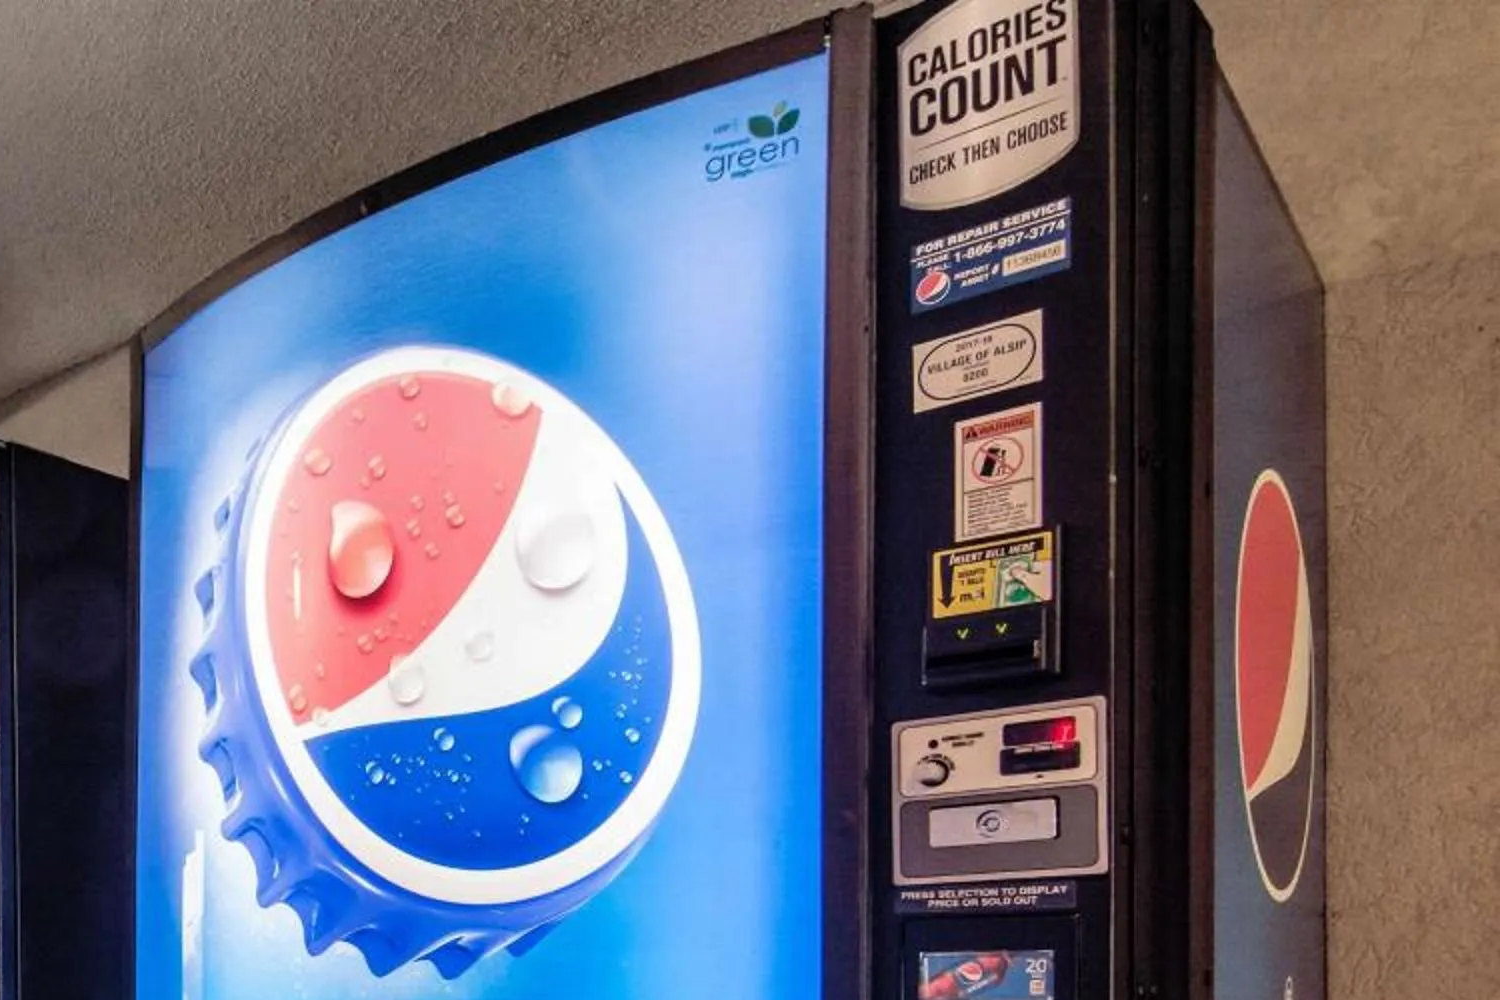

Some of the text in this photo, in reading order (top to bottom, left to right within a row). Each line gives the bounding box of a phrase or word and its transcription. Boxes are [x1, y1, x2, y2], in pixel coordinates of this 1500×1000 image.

[908, 0, 1066, 87] CALORIES
[909, 34, 1066, 137] COUNT
[705, 136, 800, 182] green
[909, 111, 1068, 185] CHECK THEN CHOOSE
[915, 199, 1067, 256] FOR REPAIR SERVICE
[927, 353, 973, 374] VILLAGE
[975, 349, 990, 361] OF
[993, 338, 1027, 357] ALSIP
[901, 885, 1068, 900] PRESS SELECTION TO DISPLAY
[927, 895, 1039, 908] PRICE OR SOLD OUT
[1025, 959, 1047, 974] 20
